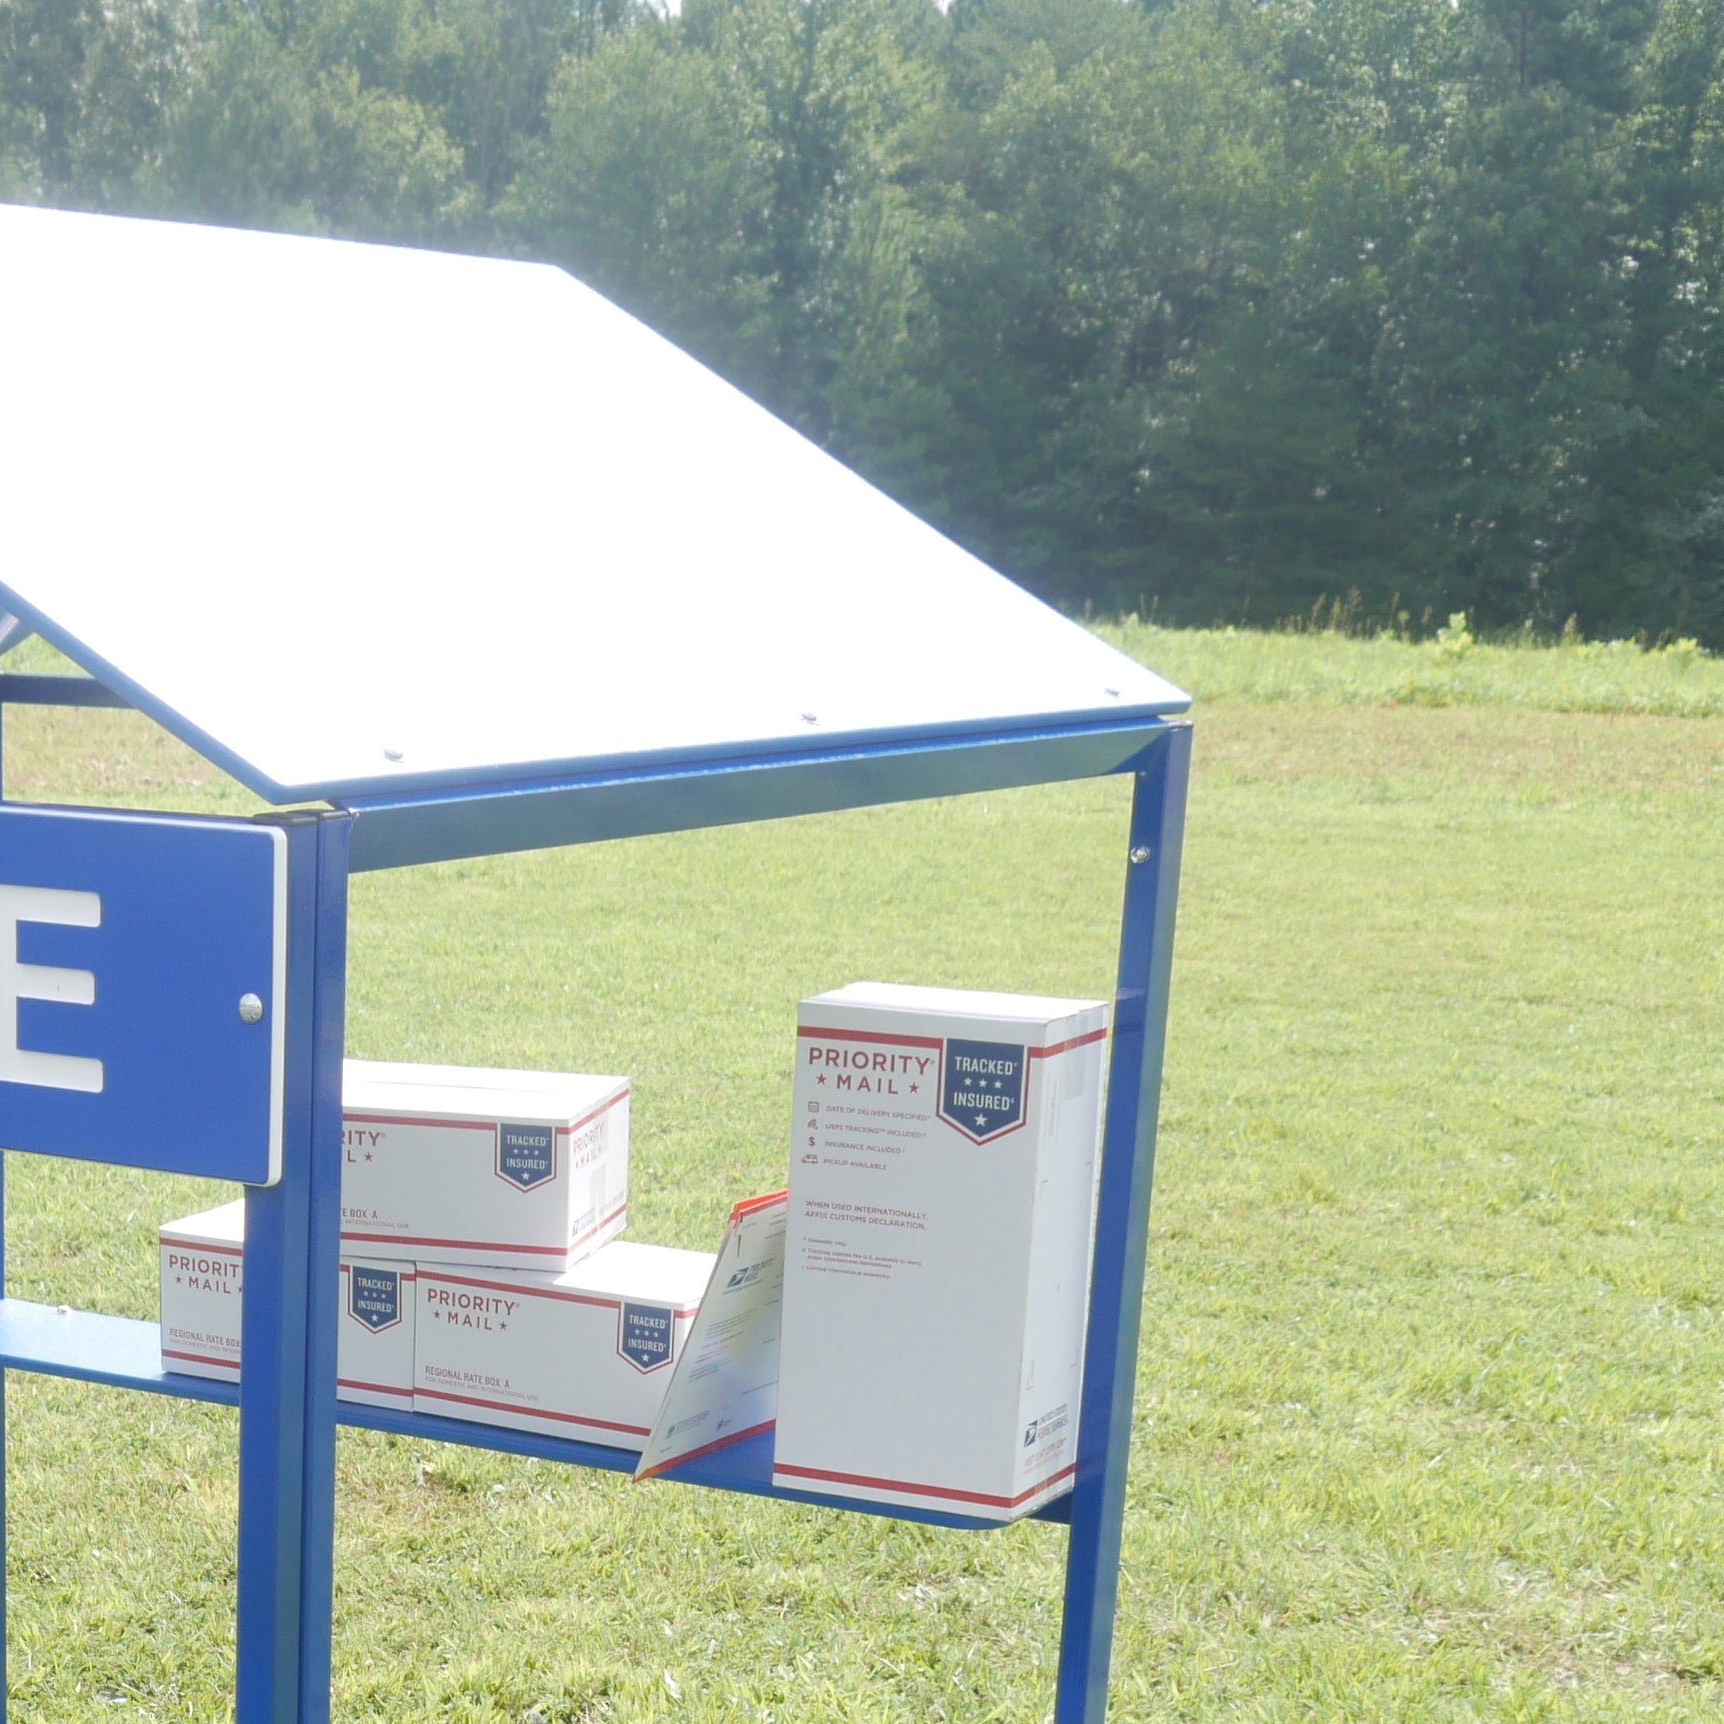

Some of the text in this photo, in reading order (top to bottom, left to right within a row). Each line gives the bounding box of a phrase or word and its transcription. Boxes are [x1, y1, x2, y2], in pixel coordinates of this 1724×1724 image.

[836, 1074, 898, 1094] MAIL
[826, 1104, 844, 1113] DATE
[857, 1108, 890, 1118] DELIVERY
[825, 1123, 844, 1131] USPS
[825, 1141, 864, 1150] INSURANCE
[823, 1158, 887, 1170] PICKUP AVAILABLE
[349, 1209, 367, 1218] BOX
[372, 1210, 378, 1219] A
[806, 1200, 829, 1209] WHEN
[831, 1203, 852, 1211] USED
[805, 1210, 926, 1230] AFFIX CUSTOMS DECLARATION.
[169, 1254, 244, 1278] PRIORIT
[189, 1275, 231, 1294] MAIL
[447, 1311, 492, 1330] MAIL
[169, 1328, 240, 1347] REGIONAL RATE BOX
[425, 1366, 510, 1388] REGIONAL RATE BOX A
